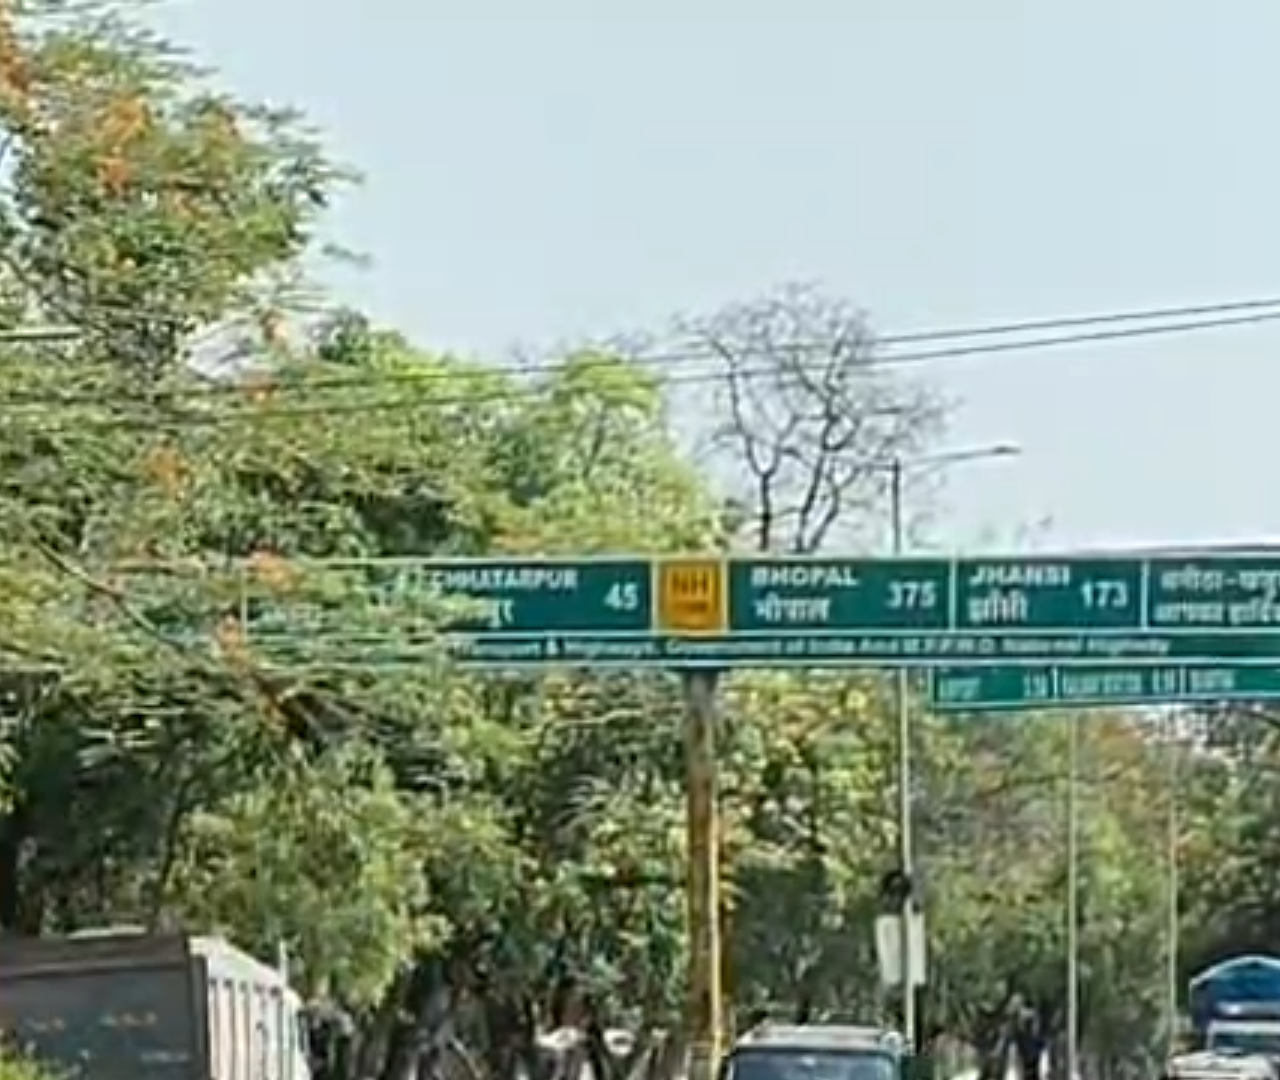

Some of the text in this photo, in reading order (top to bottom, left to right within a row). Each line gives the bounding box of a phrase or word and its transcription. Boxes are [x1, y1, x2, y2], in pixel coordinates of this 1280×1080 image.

[672, 569, 709, 595] NH
[750, 566, 859, 587] BHOPAL
[969, 565, 1071, 587] JHANSI
[603, 582, 639, 610] 45
[888, 581, 937, 608] 375
[1080, 580, 1128, 608] 173
